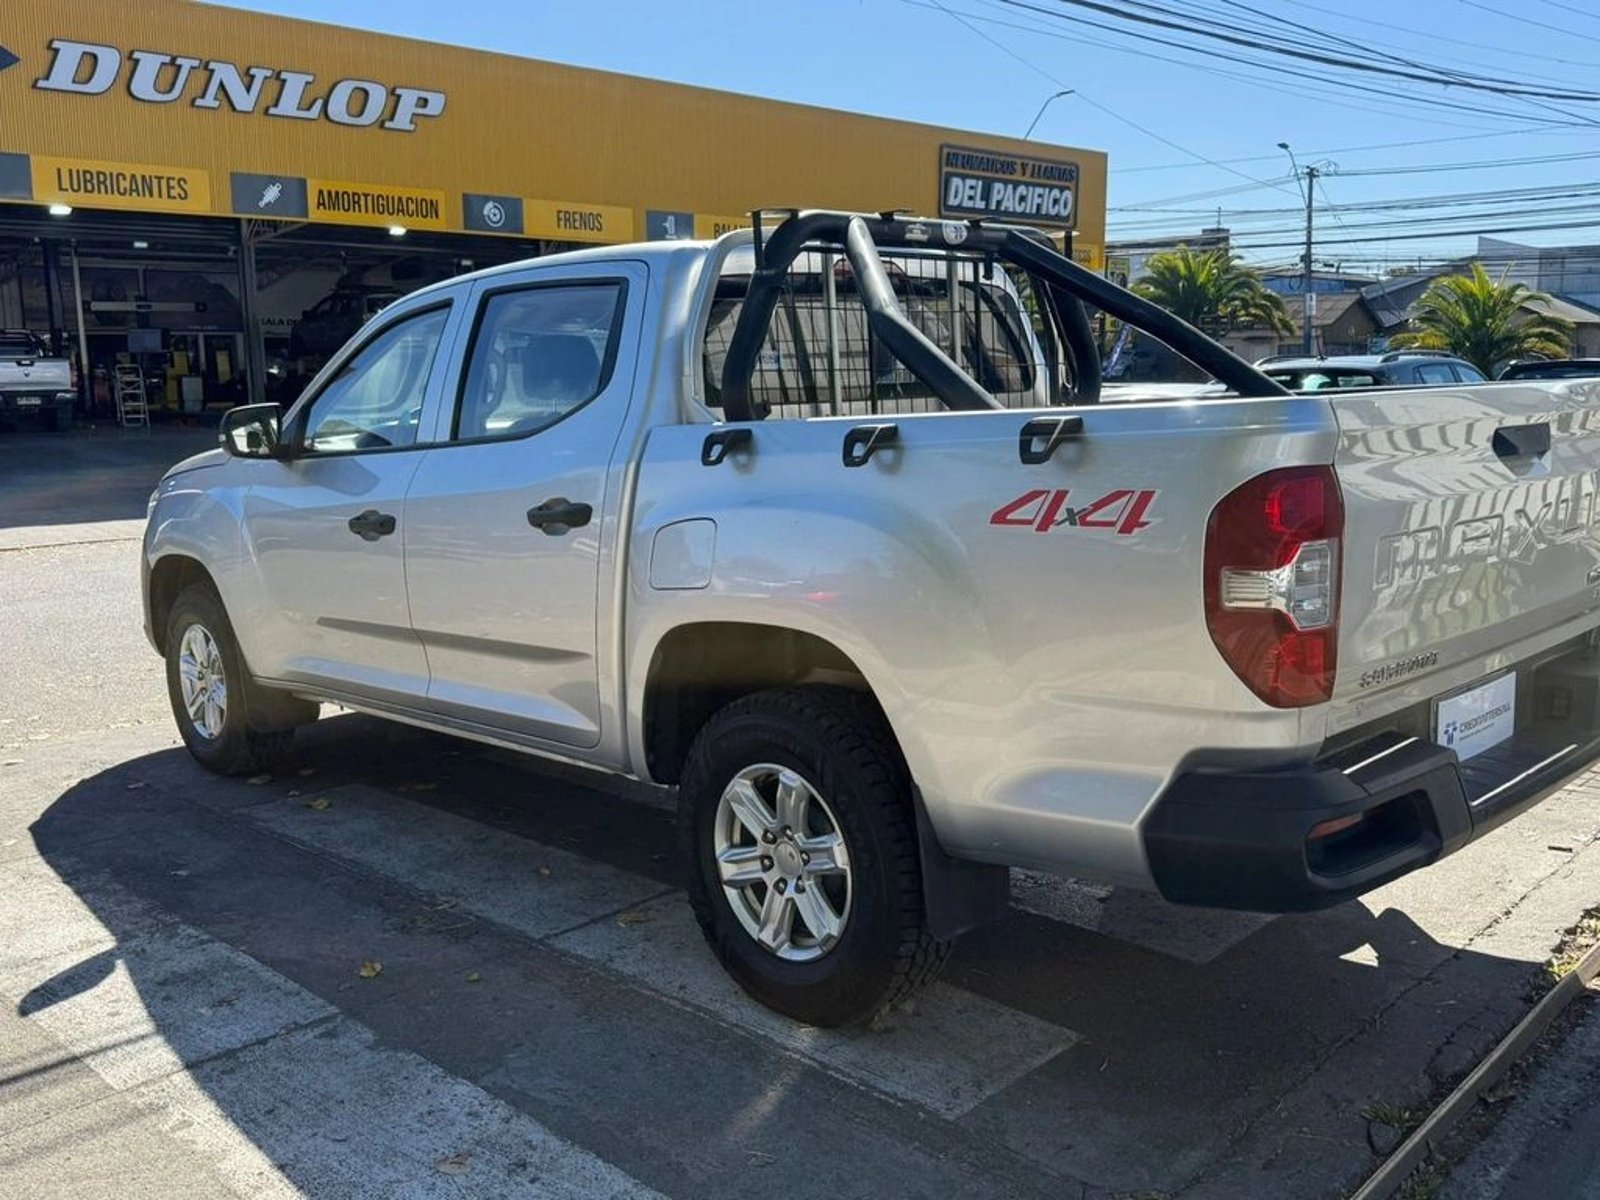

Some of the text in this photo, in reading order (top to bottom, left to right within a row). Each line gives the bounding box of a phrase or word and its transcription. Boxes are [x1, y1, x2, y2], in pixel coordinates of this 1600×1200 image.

[34, 39, 446, 132] DUNLOP
[946, 151, 1075, 182] NEUMATICOS Y LLANTAS
[56, 167, 188, 201] LUBRICANTES
[948, 177, 1072, 217] DEL PACIFICO
[317, 189, 440, 220] AMORTIGUACION
[556, 209, 603, 232] FRENOS
[989, 488, 1158, 535] 4x4
